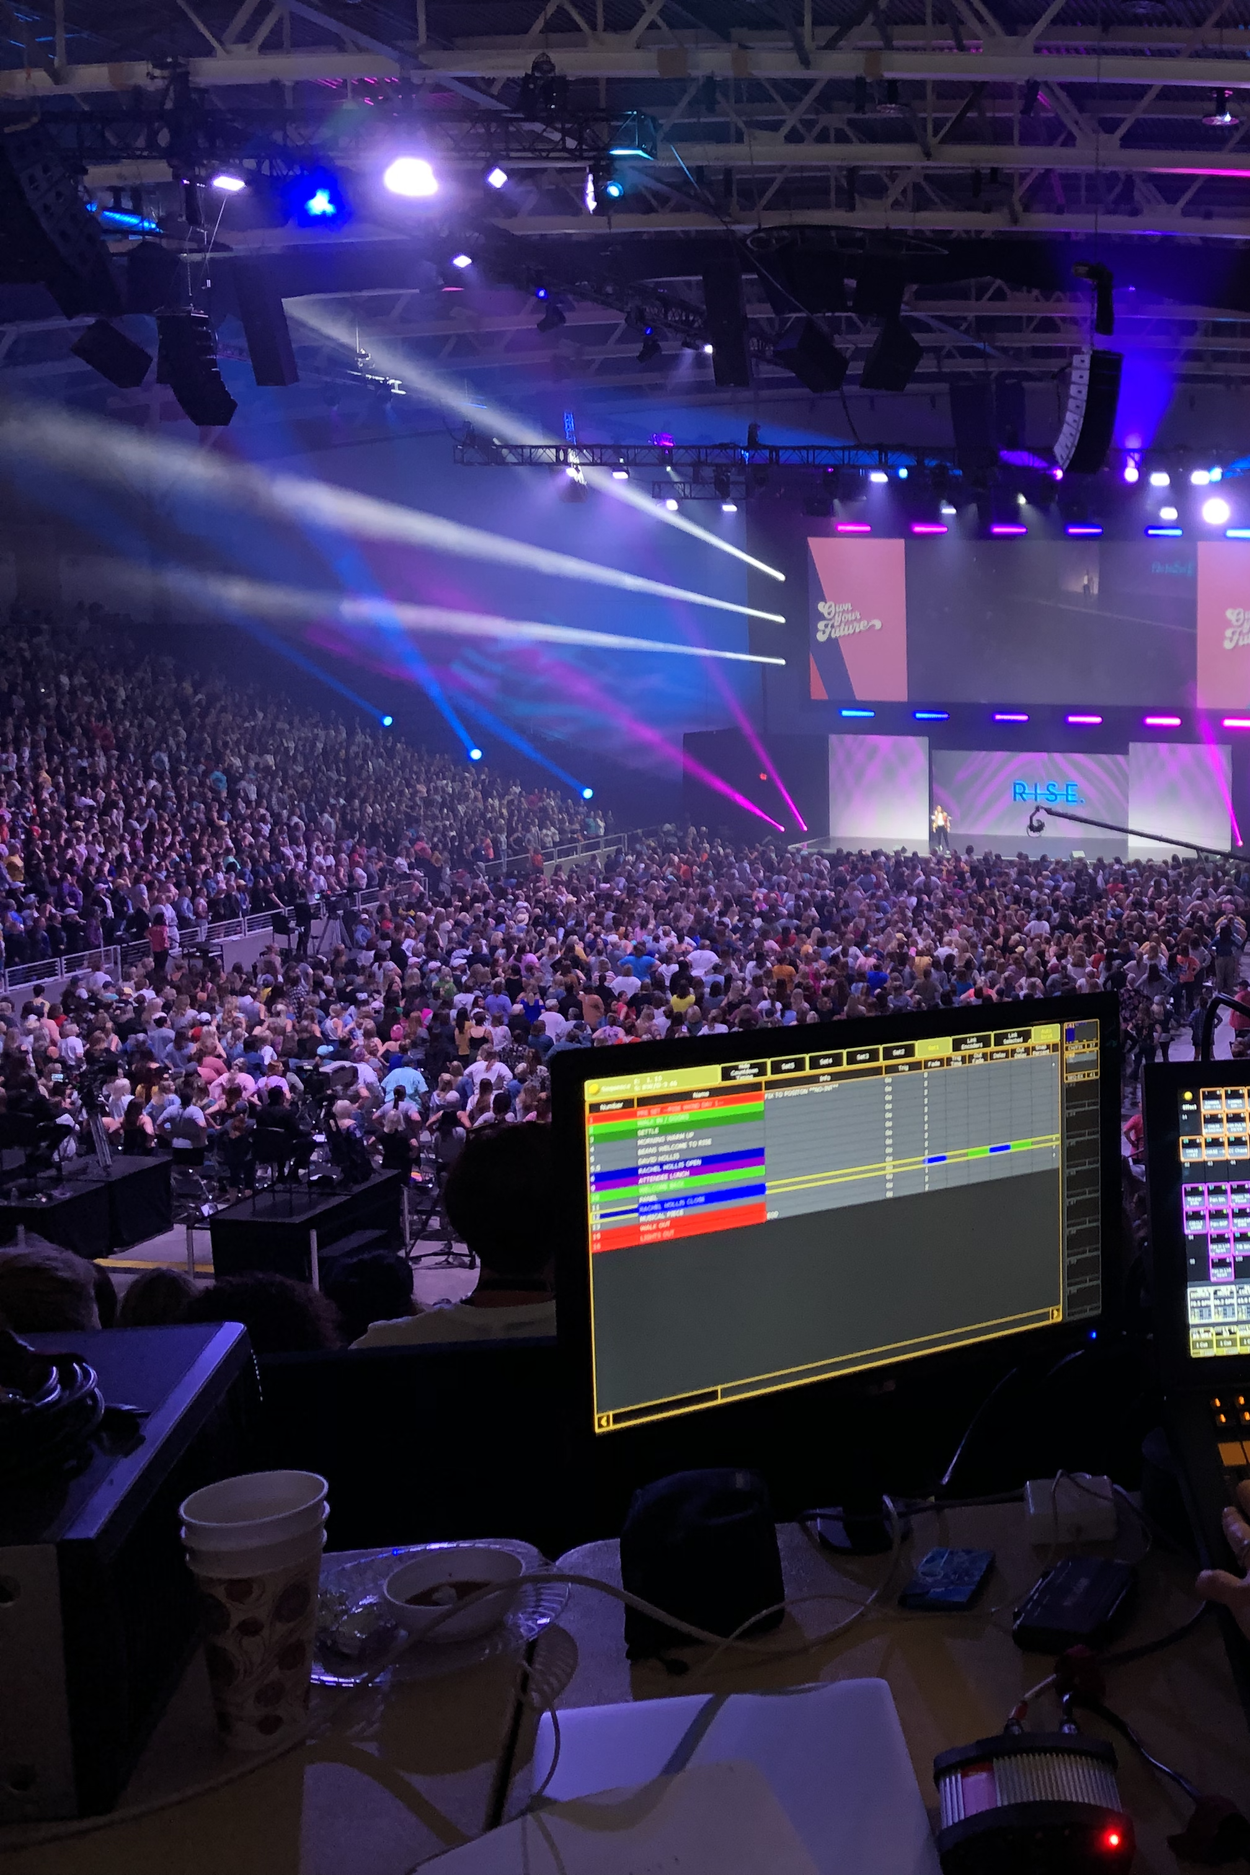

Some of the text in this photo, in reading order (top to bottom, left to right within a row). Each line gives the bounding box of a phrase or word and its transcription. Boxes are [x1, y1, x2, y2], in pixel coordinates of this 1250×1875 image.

[818, 601, 852, 619] Own
[816, 619, 882, 642] Future
[693, 1091, 710, 1099] Name
[600, 1102, 624, 1111] Number
[637, 1127, 660, 1137] SETTLE
[637, 1136, 666, 1146] MORNING
[666, 1134, 685, 1143] WARM
[658, 1142, 688, 1153] WELCOME
[688, 1141, 698, 1149] TO
[698, 1138, 712, 1147] RISE
[658, 1152, 680, 1162] HOLLIS
[638, 1159, 702, 1175] RACHEL HOLLIS OPEN
[639, 1203, 662, 1213] RACHEL
[663, 1200, 685, 1210] HOLLIS
[639, 1220, 671, 1232] WALK OUT
[662, 1229, 675, 1238] OUT
